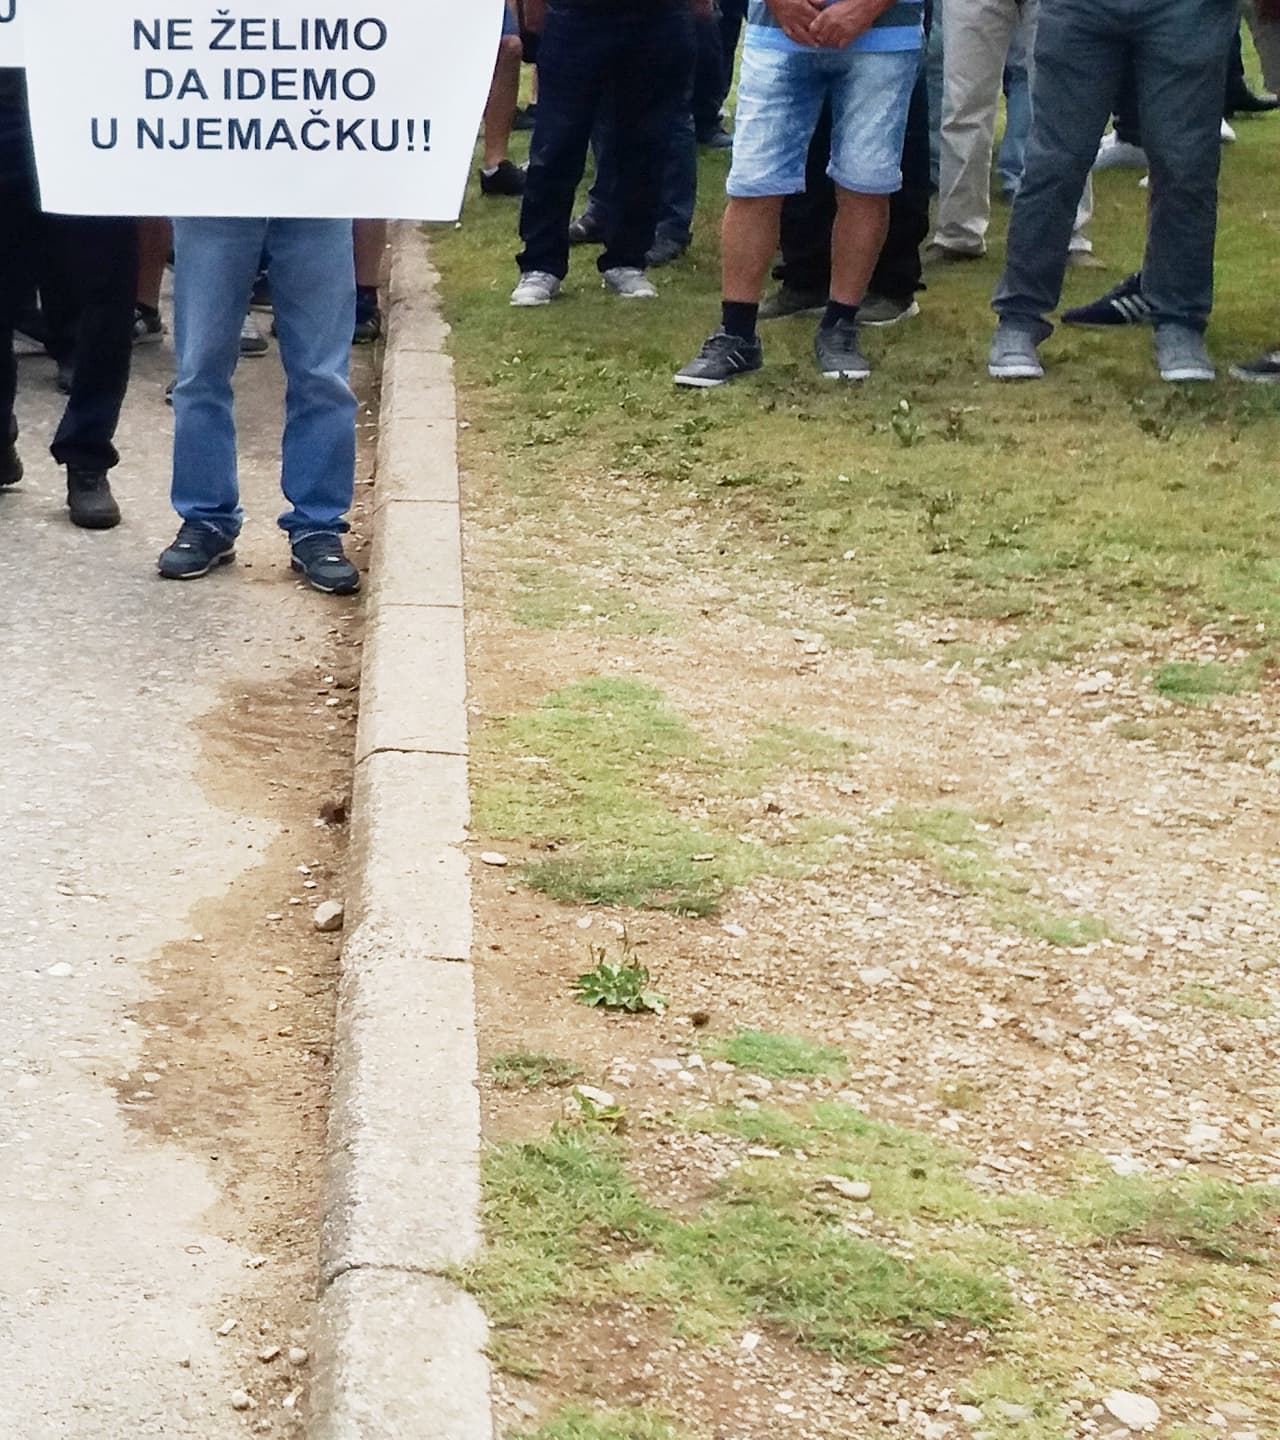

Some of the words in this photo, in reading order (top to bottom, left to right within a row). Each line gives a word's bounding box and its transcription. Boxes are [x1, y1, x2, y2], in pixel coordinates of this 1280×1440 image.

[133, 18, 194, 51] NE
[208, 9, 388, 51] ŽELIMO
[144, 67, 209, 101] DA
[223, 67, 376, 102] IDEMO
[91, 117, 118, 150] U
[136, 108, 431, 152] NJEMAČKU!!
